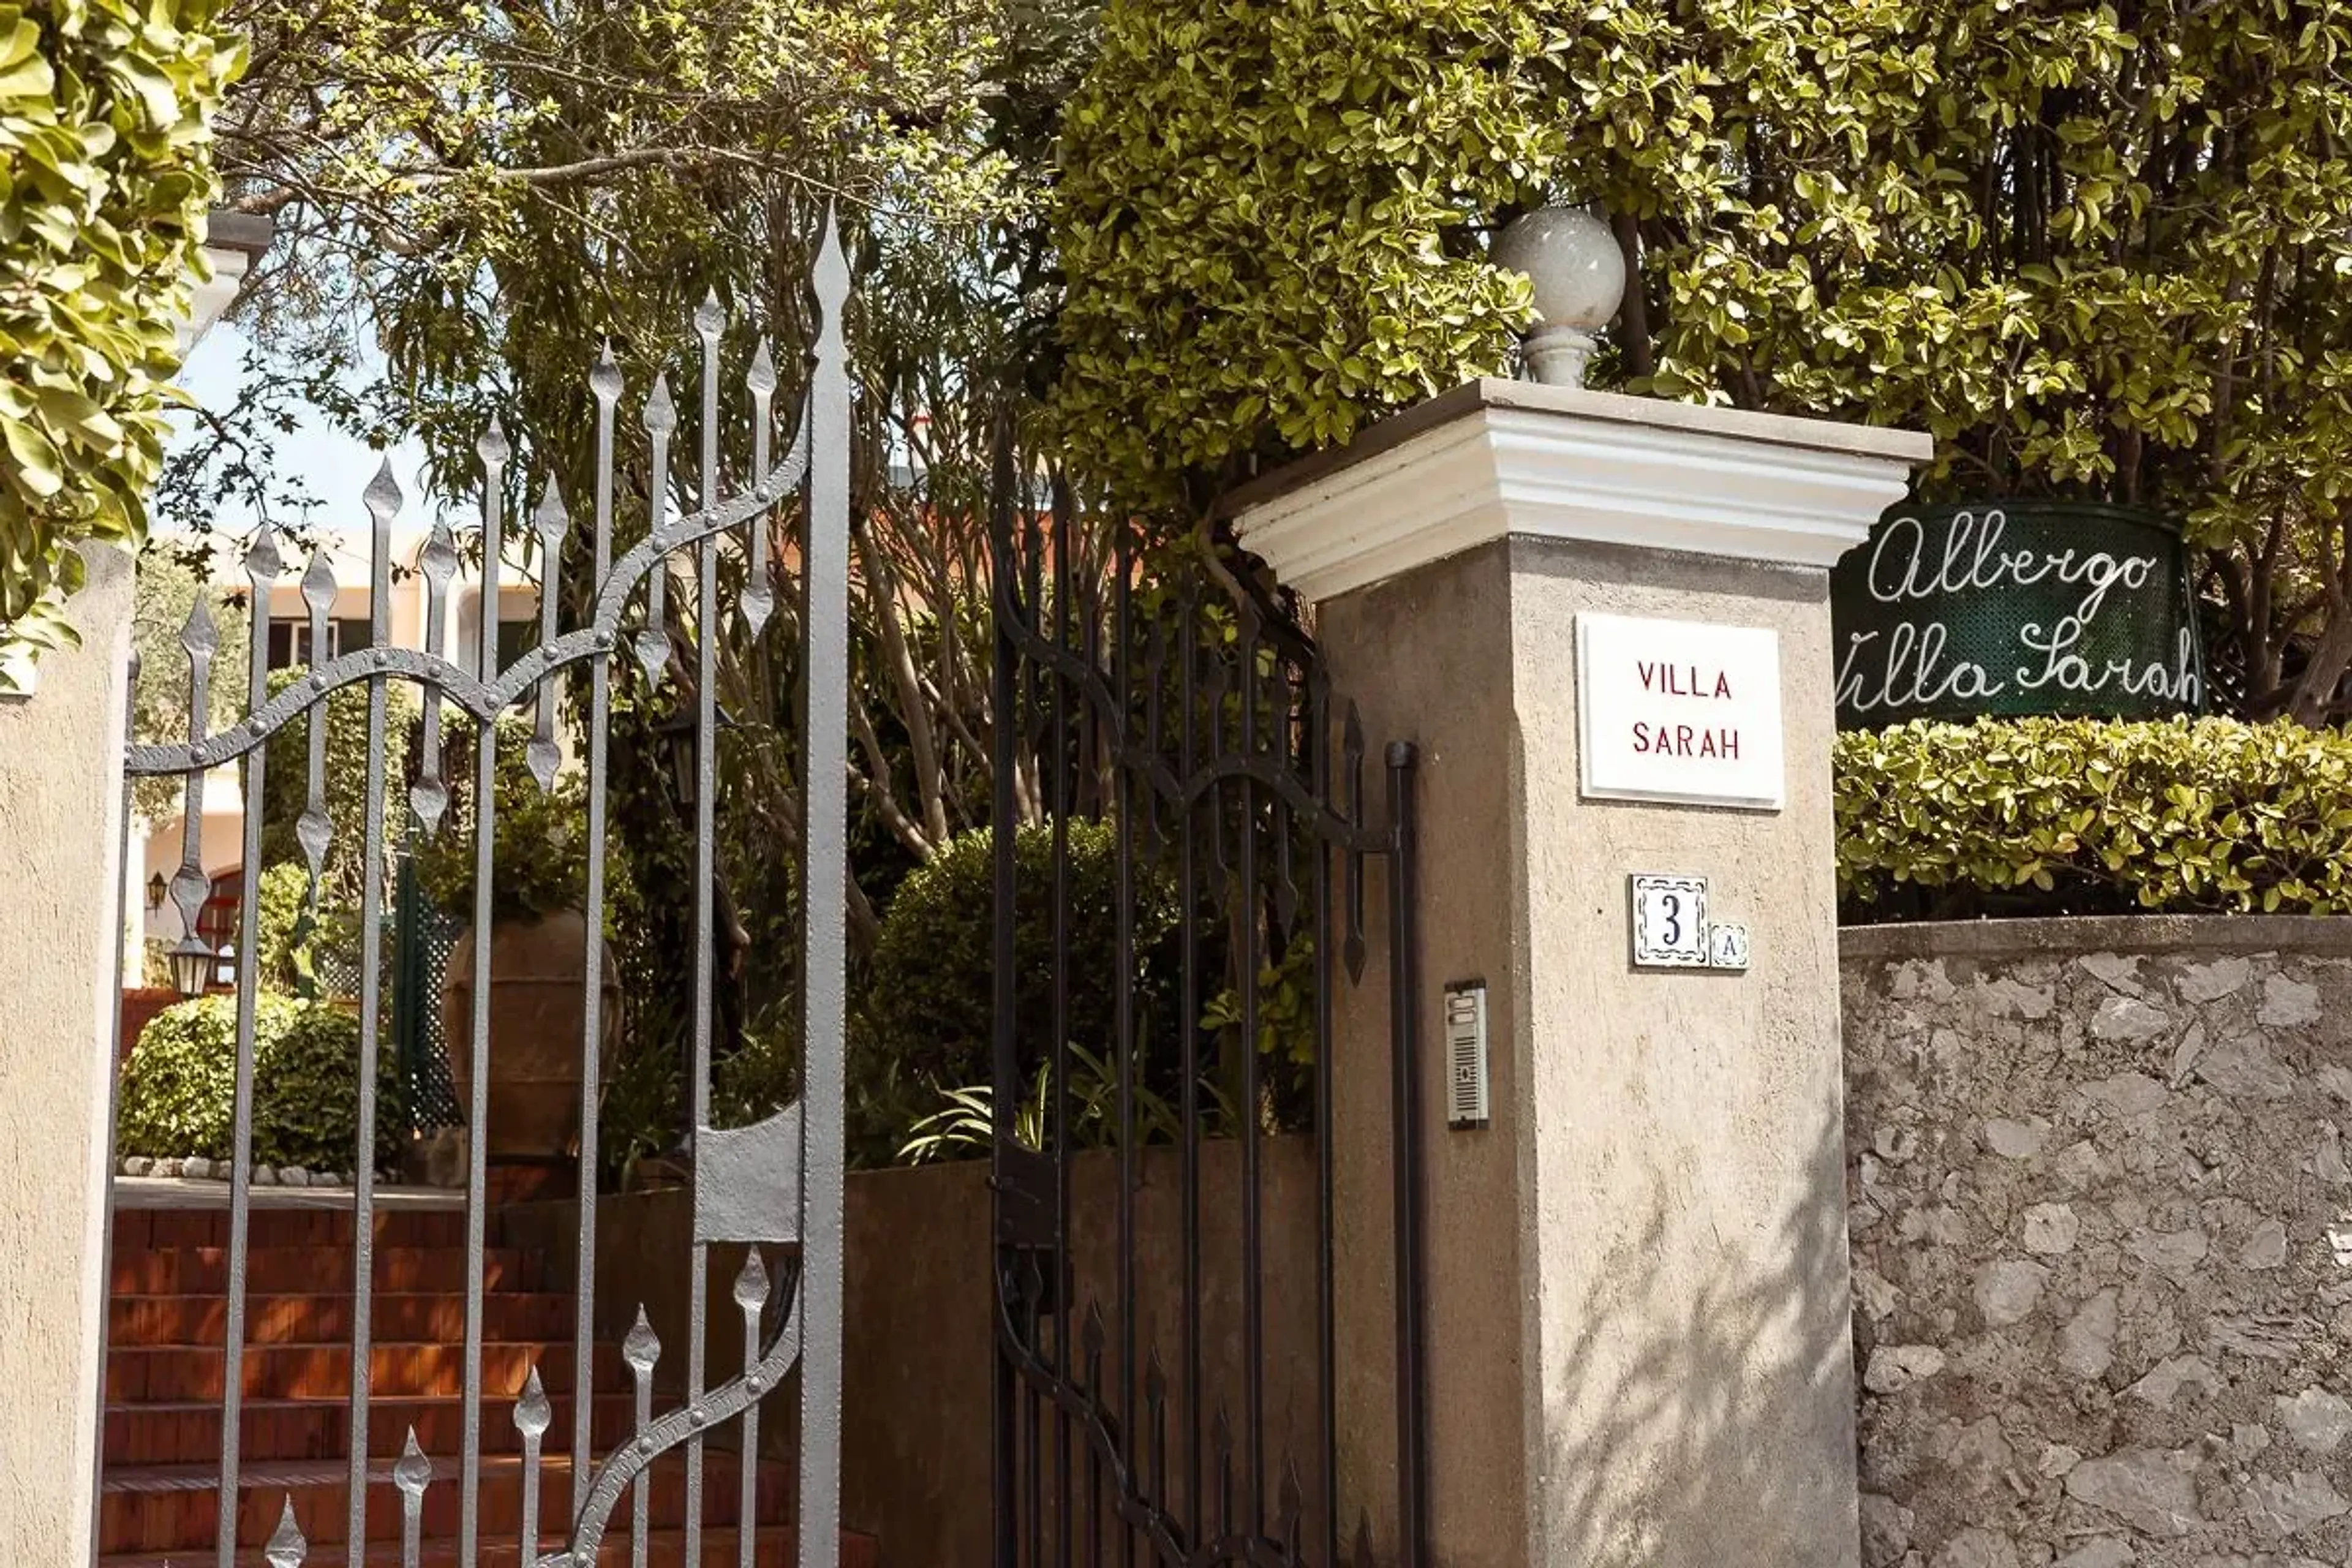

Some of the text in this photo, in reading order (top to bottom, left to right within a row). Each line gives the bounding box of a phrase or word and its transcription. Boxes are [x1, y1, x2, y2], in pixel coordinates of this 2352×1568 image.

[1869, 510, 2157, 624] Albergo
[1637, 660, 1732, 699] VILLA
[2017, 616, 2200, 706] Sarah
[1632, 721, 1740, 760] SARAH
[1662, 894, 1681, 946] 3
[1722, 935, 1737, 956] A
